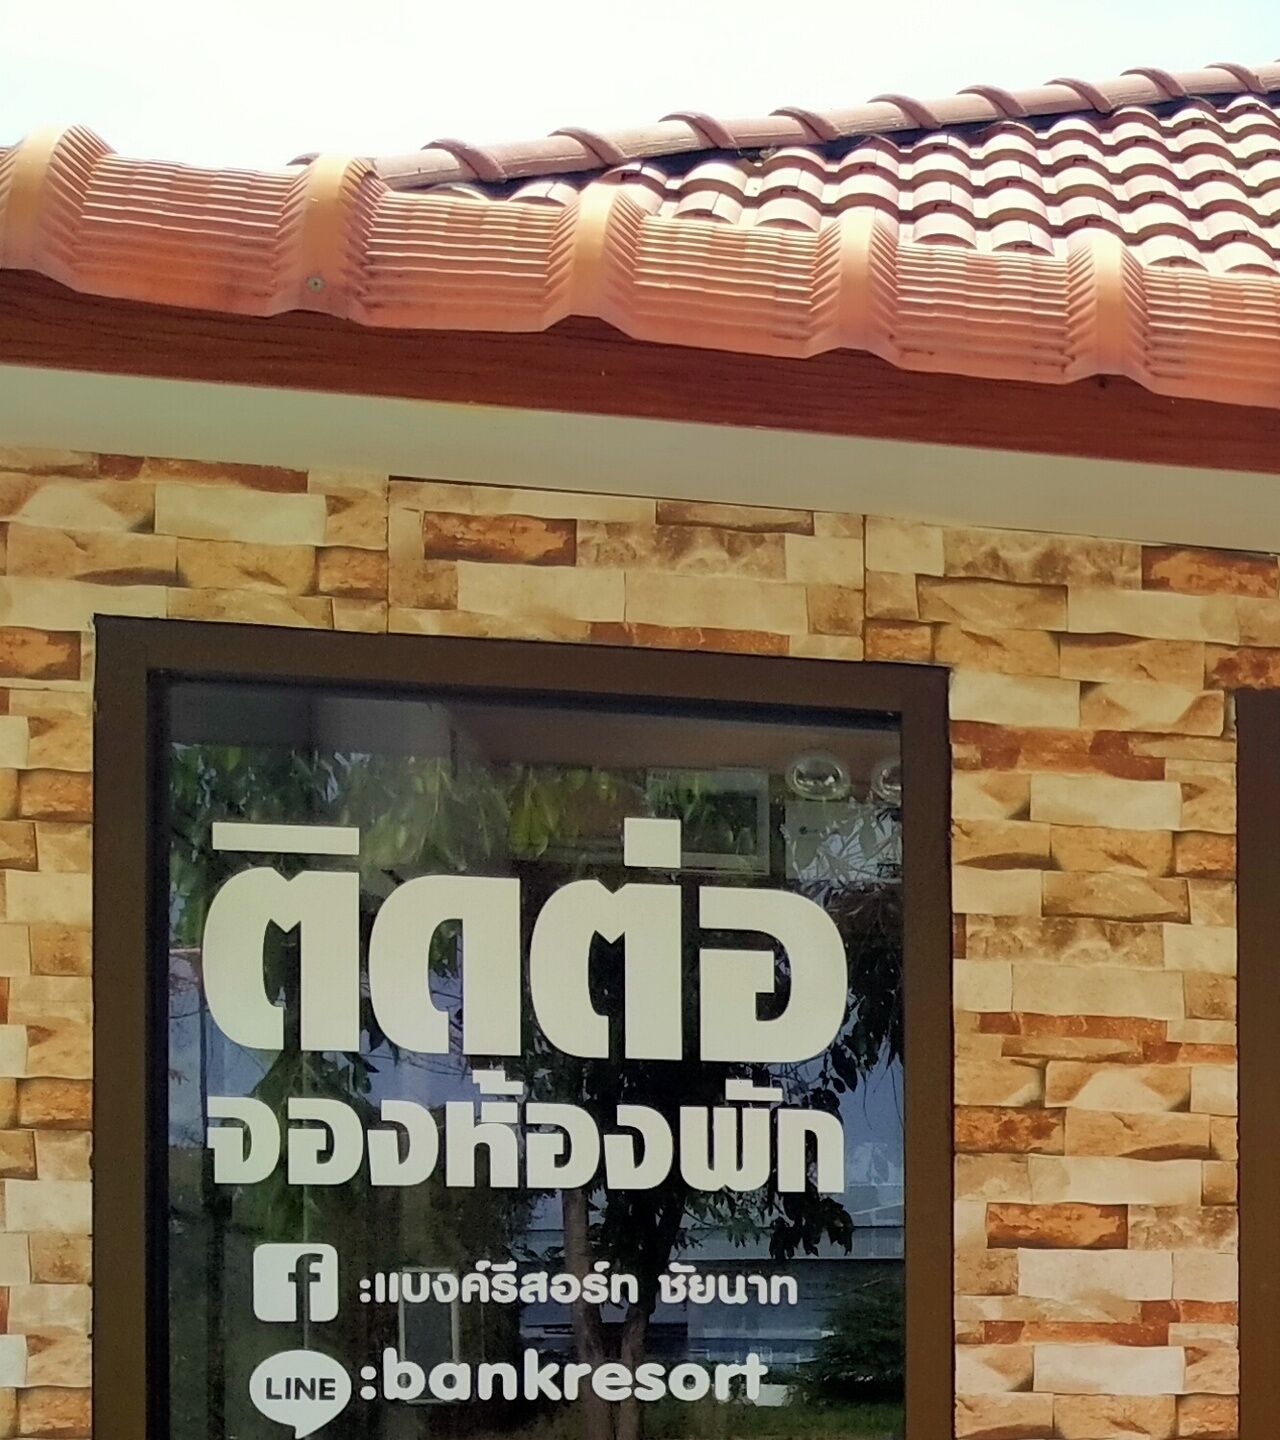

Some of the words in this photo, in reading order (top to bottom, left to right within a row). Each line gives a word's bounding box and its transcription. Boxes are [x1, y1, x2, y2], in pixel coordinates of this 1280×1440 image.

[203, 817, 849, 1063] ติดต่อ
[206, 1069, 846, 1194] จองห้องพัก
[657, 1263, 798, 1306] ชัยนาท
[265, 1377, 337, 1401] LINE
